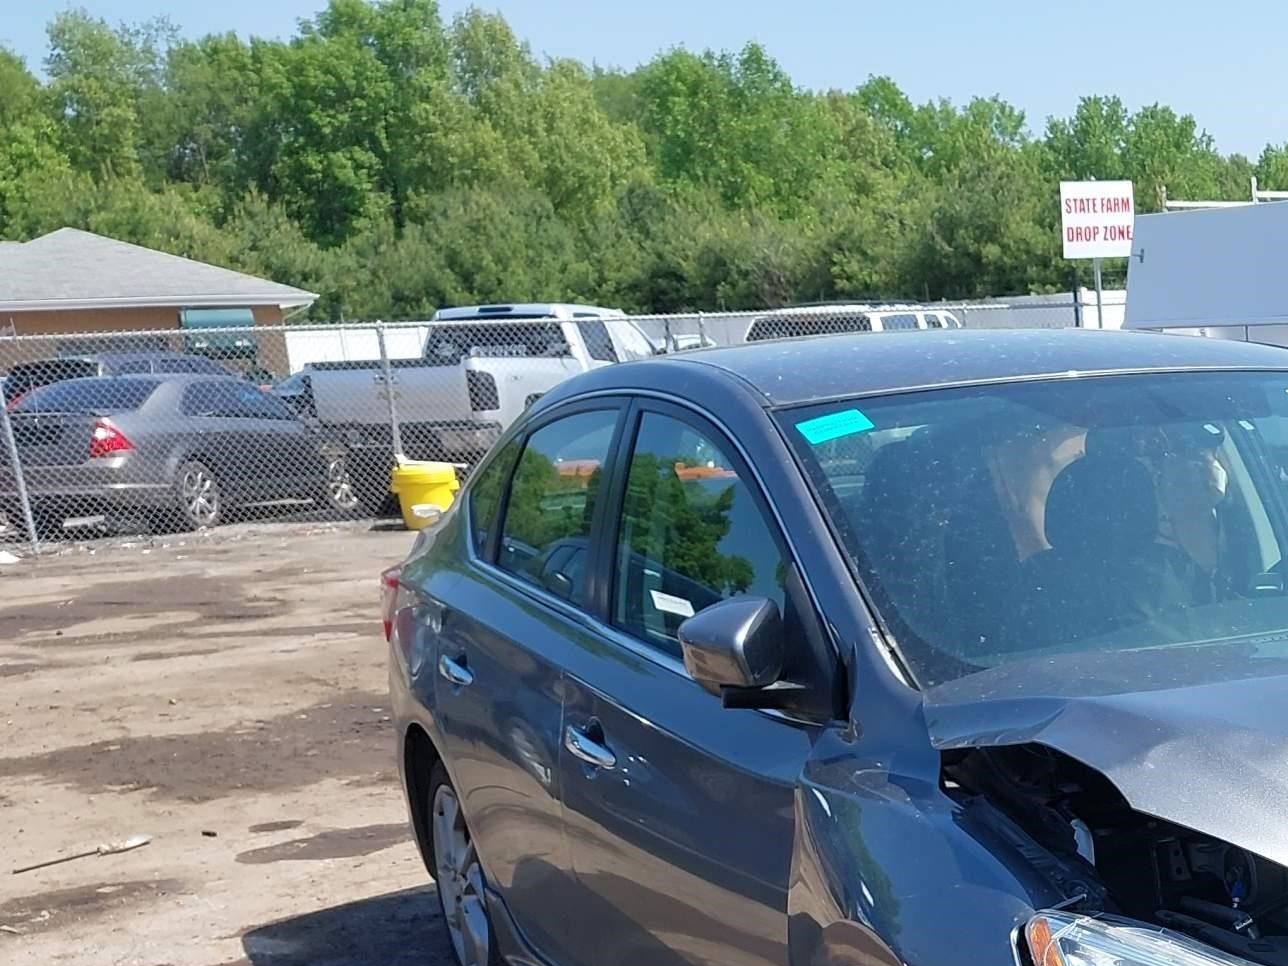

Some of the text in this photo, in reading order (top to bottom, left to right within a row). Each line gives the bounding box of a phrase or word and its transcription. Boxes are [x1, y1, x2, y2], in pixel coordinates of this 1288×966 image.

[1065, 197, 1131, 214] STATE FARM
[1066, 224, 1133, 242] DROP ZONE
